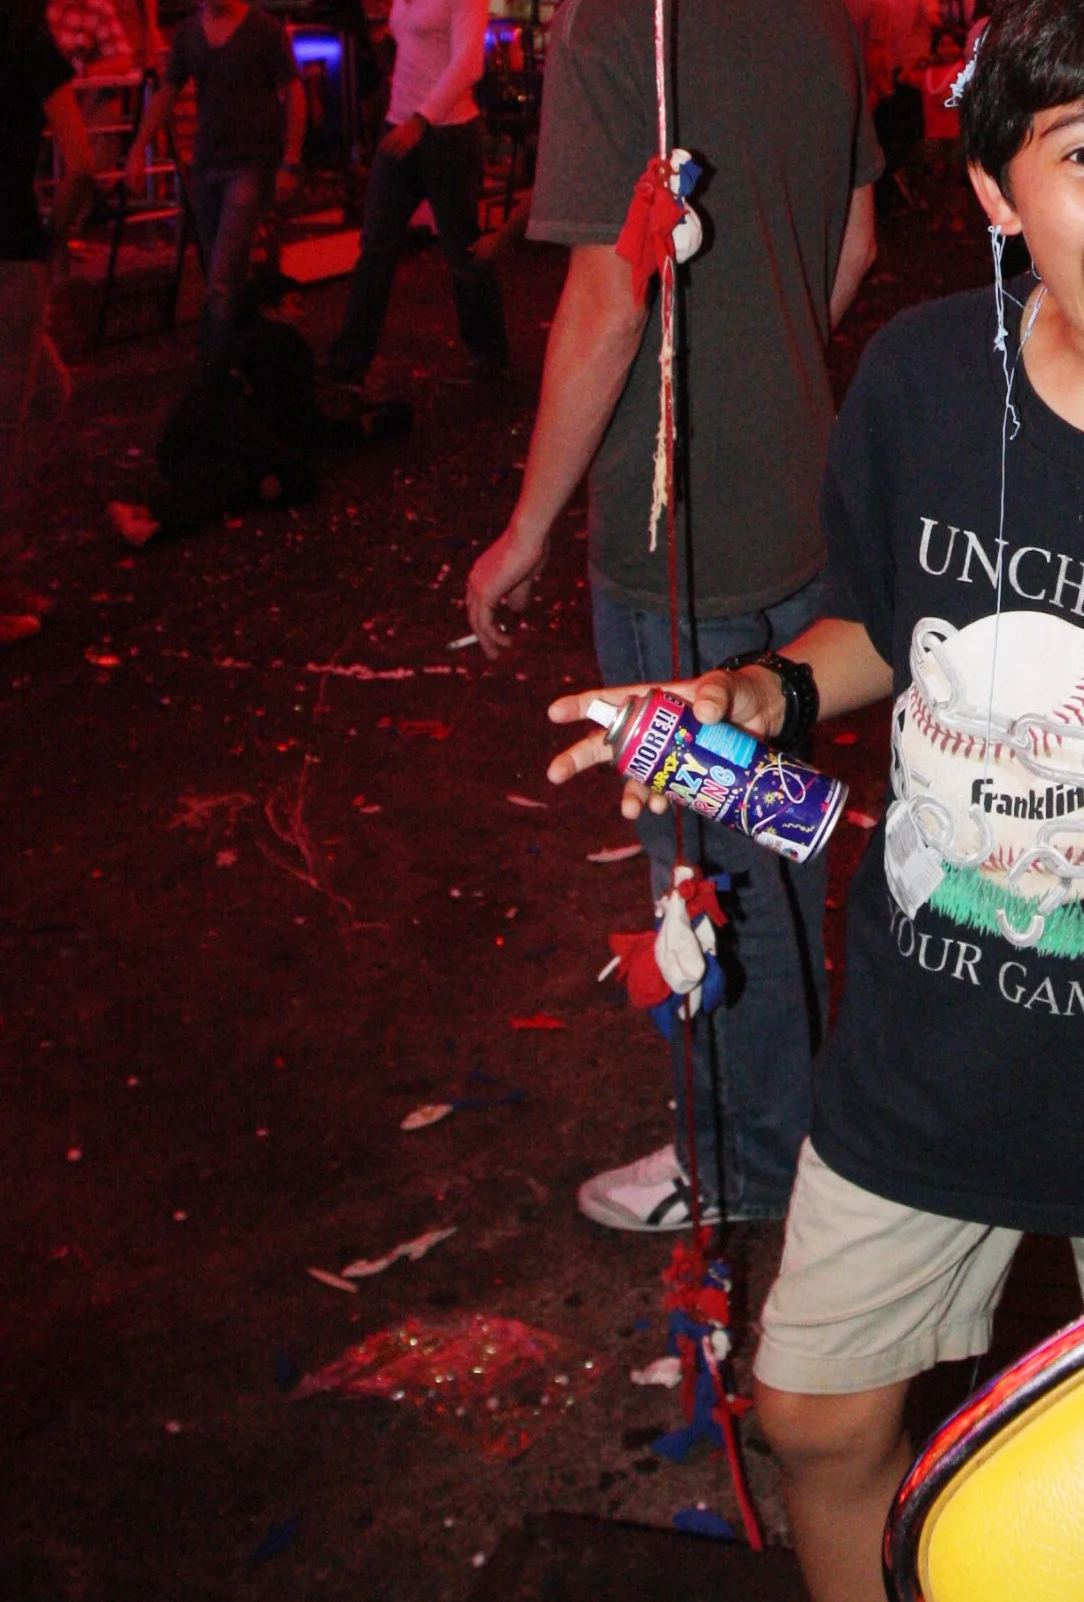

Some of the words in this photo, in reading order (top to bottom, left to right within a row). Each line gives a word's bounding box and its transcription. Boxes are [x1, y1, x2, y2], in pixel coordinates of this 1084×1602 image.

[666, 752, 709, 806] RAZY
[693, 765, 736, 816] RING
[970, 778, 1084, 820] Franklin
[887, 894, 982, 986] YOUR
